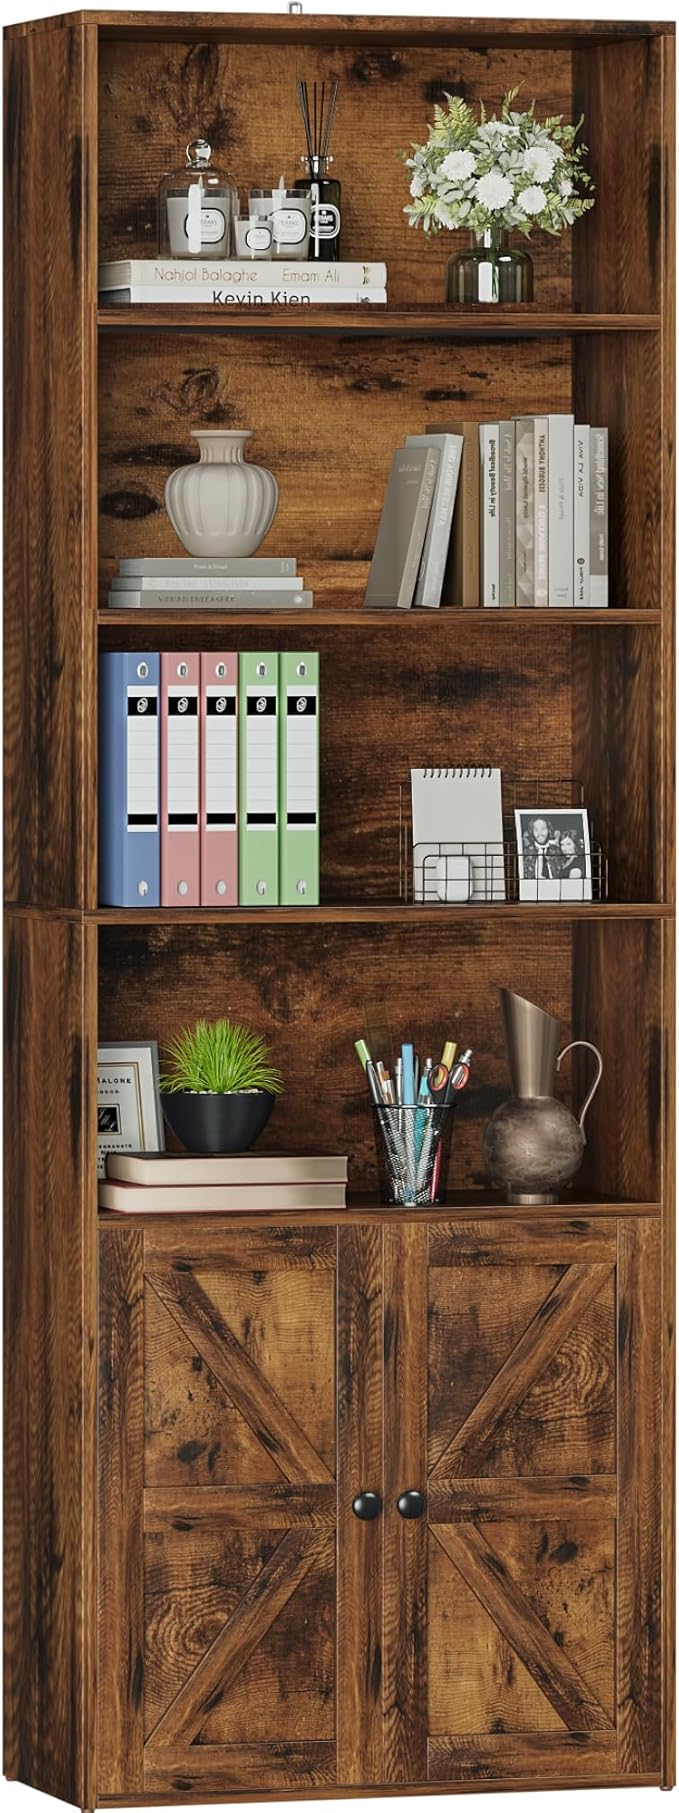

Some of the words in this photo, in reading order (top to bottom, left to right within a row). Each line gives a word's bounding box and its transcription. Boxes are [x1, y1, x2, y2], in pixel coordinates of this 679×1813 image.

[154, 267, 198, 283] Nahjol
[201, 267, 258, 283] Balaghe
[282, 268, 320, 282] Emam
[324, 268, 340, 282] Ali
[212, 290, 266, 306] Kevin
[270, 290, 311, 306] Kien
